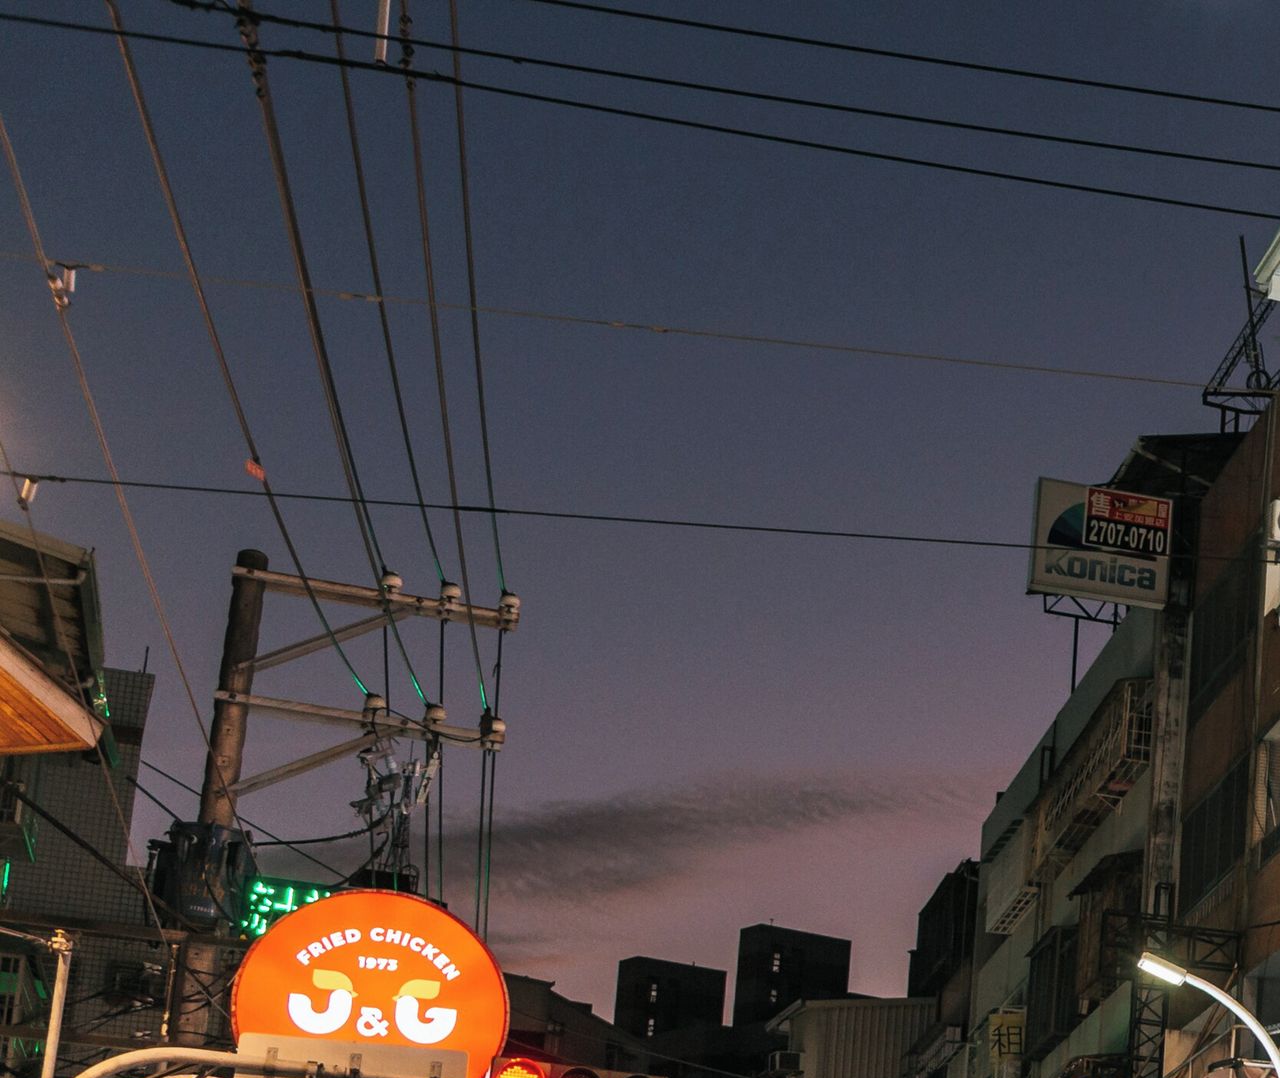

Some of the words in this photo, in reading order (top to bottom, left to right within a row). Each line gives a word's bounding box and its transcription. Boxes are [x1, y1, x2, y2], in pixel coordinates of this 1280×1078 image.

[1089, 519, 1164, 552] 2707-0710
[1045, 551, 1157, 590] Konica
[296, 928, 361, 966] FRIED
[369, 927, 461, 981] CHICKEN
[358, 955, 398, 971] 1973
[287, 985, 457, 1044] J&G
